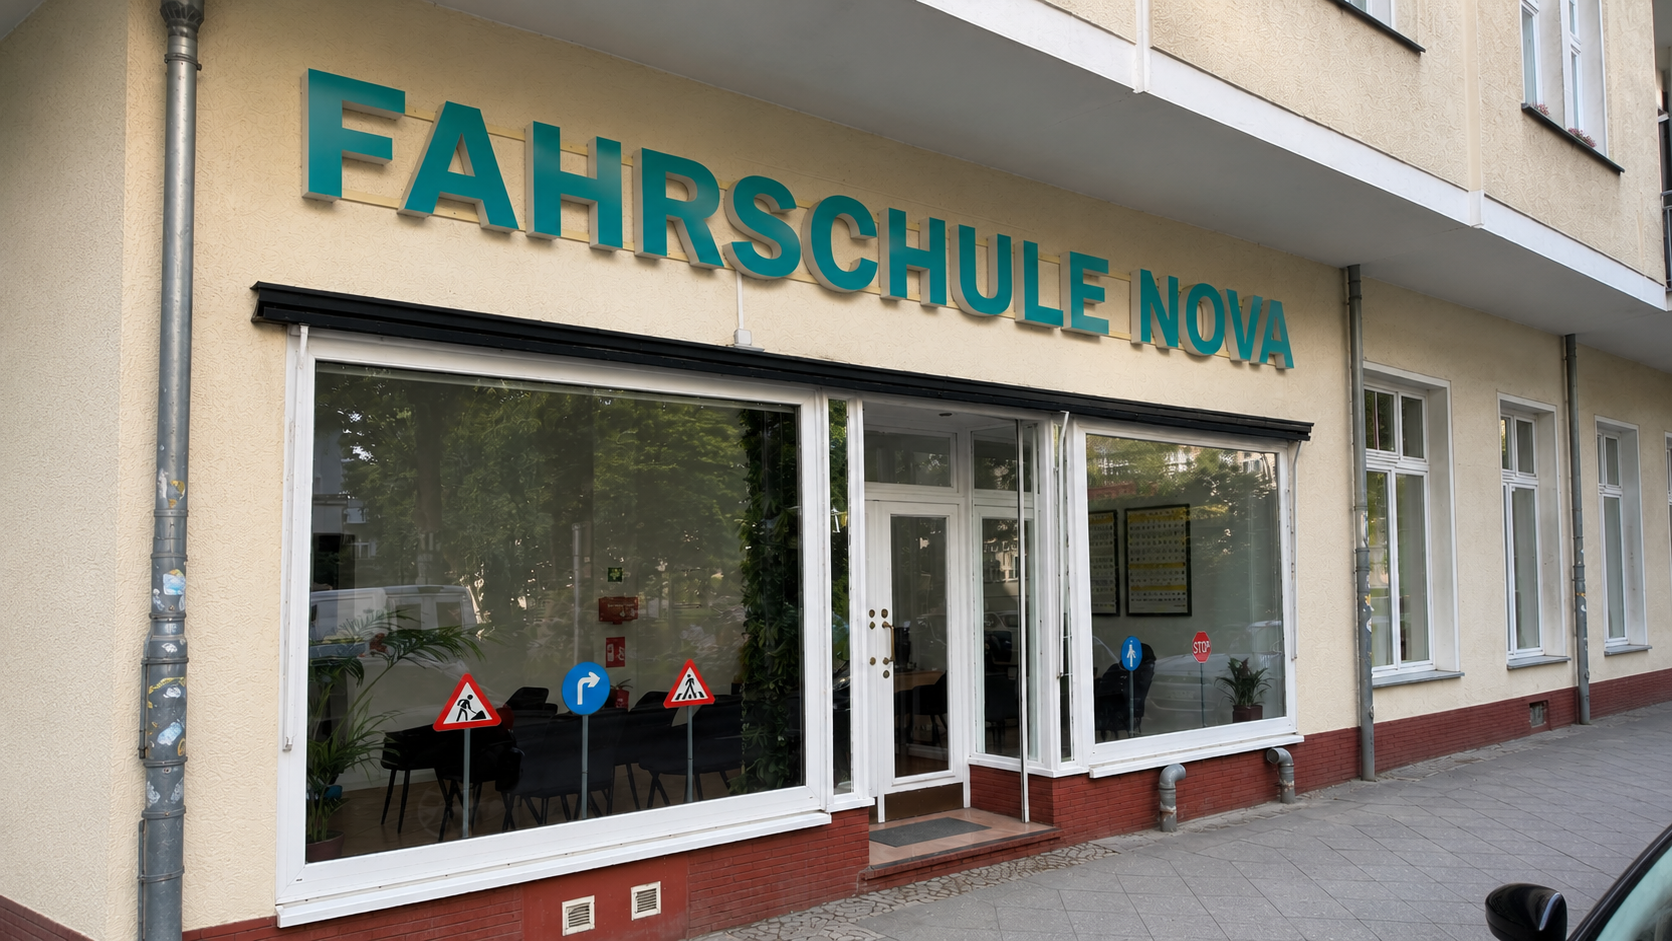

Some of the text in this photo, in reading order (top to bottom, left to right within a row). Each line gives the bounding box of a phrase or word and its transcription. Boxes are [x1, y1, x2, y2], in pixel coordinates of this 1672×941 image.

[304, 68, 1294, 369] FAHRSCHULE NOVA
[1193, 641, 1210, 654] STOP
